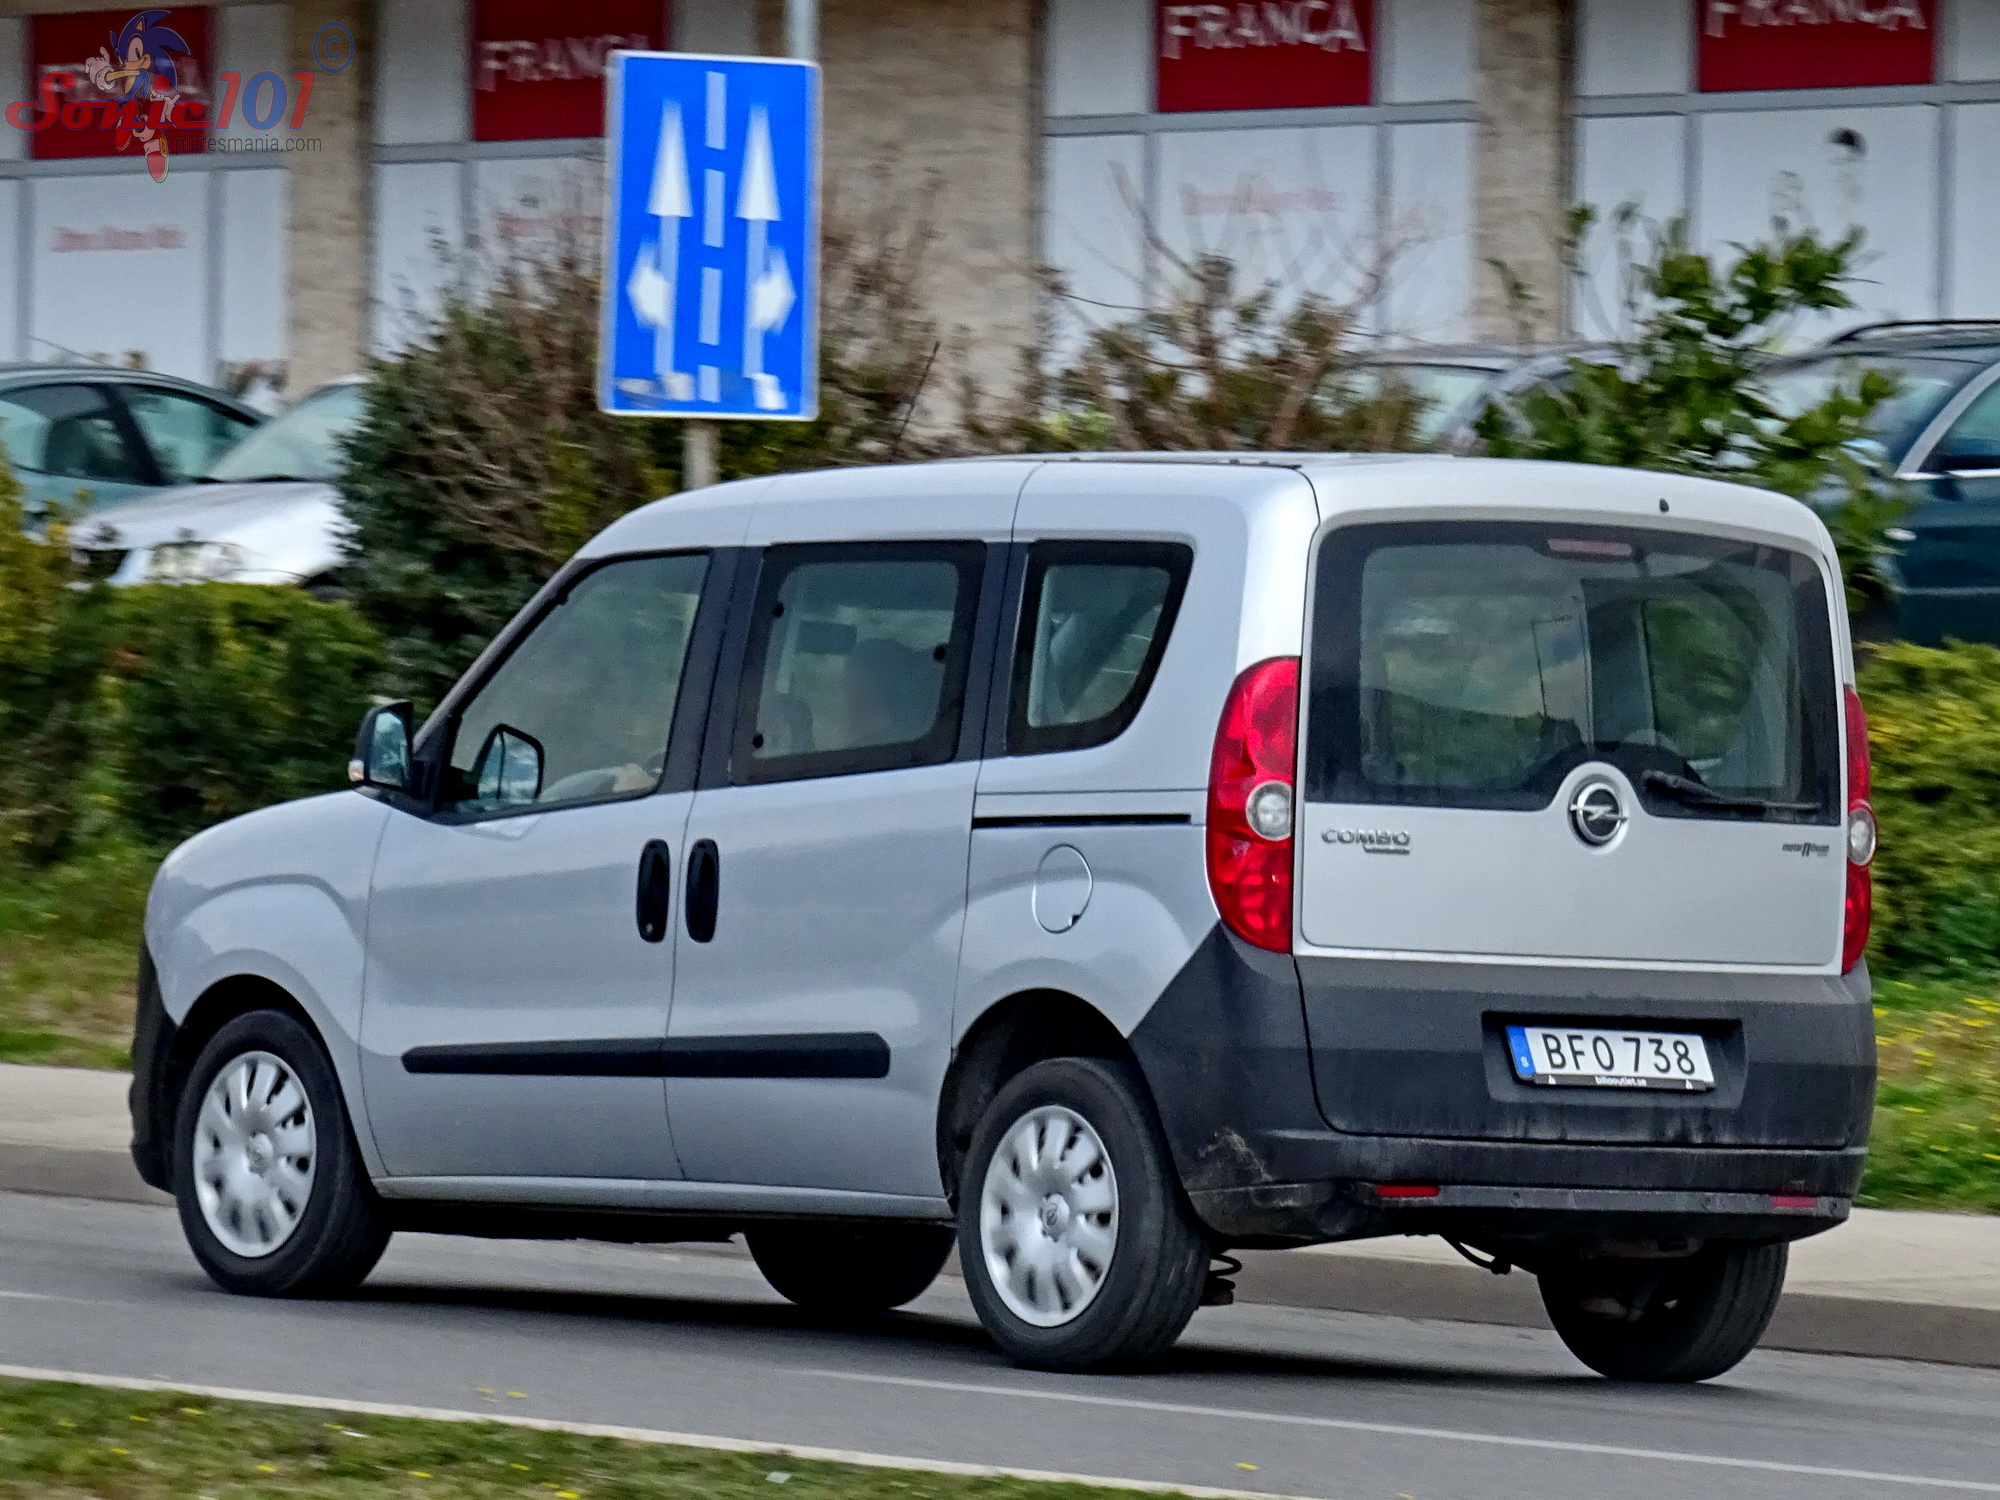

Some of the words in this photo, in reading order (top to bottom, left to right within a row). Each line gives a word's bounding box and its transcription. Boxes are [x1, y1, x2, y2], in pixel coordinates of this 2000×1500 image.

[1161, 0, 1367, 59] FRANCA
[1321, 828, 1411, 846] COMBO
[1541, 1033, 1615, 1072] BFO
[1622, 1036, 1696, 1075] 738
